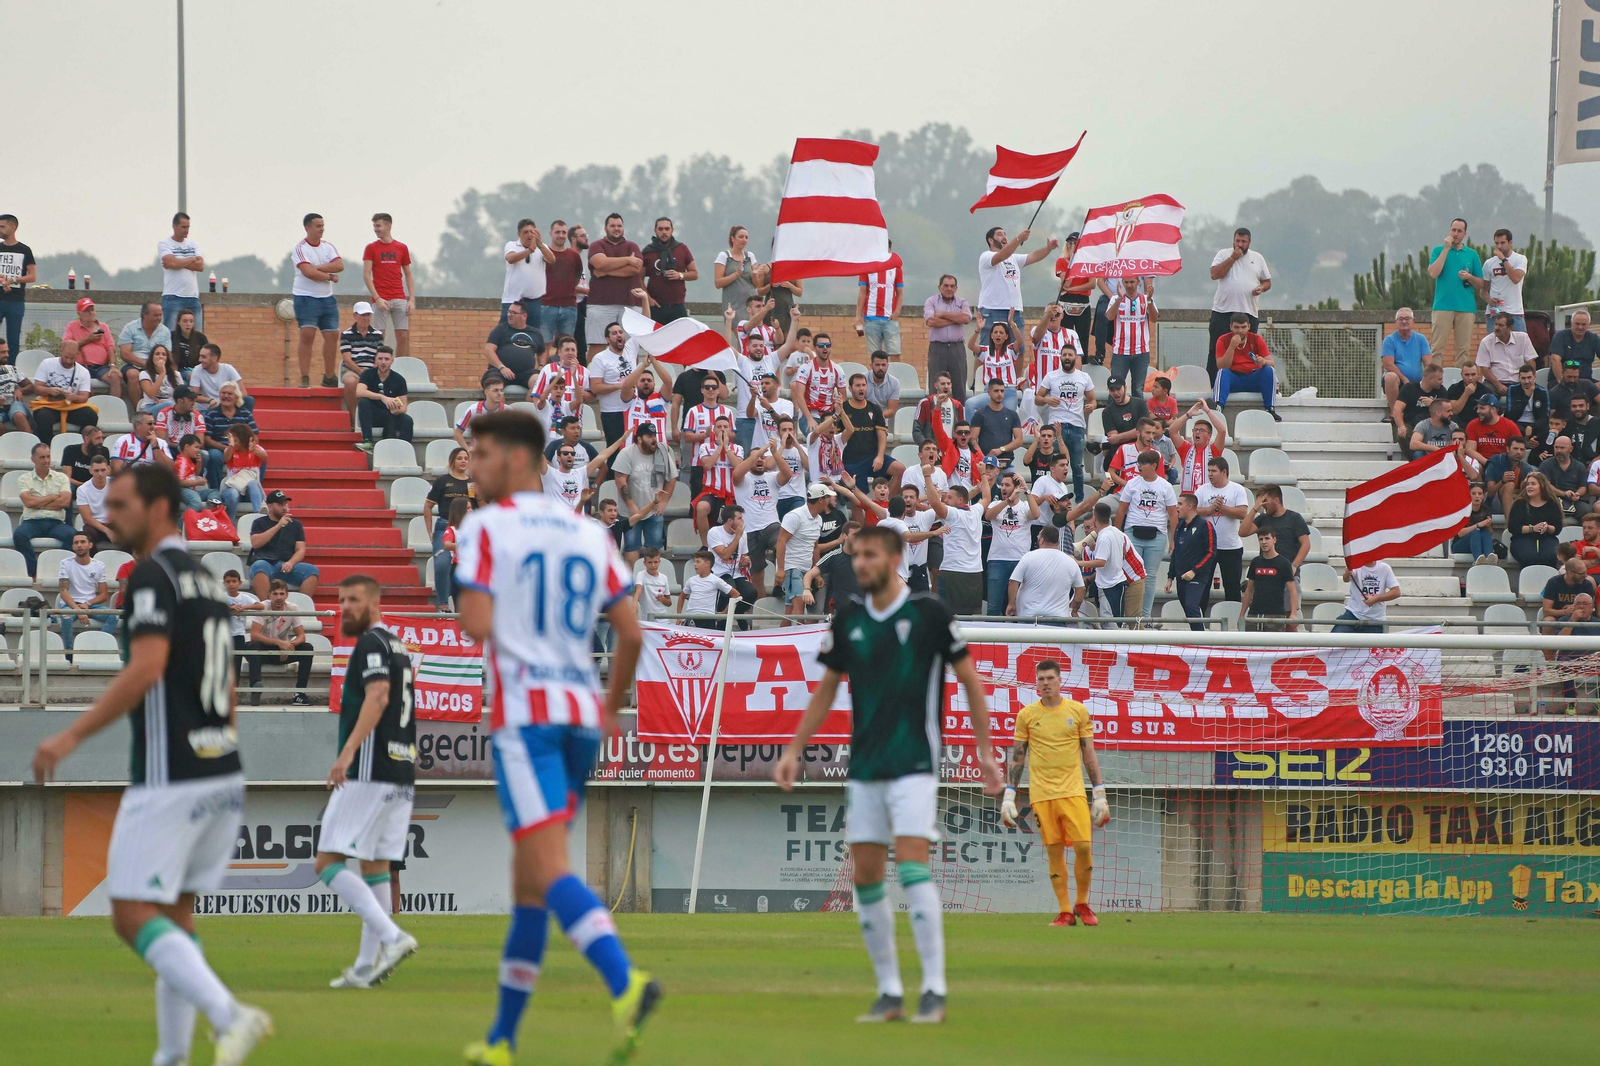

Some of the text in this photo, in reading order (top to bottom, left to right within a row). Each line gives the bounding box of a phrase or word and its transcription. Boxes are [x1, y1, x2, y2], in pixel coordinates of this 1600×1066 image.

[1080, 259, 1162, 274] ALGECIRAS C.F.
[1104, 268, 1123, 277] 1909
[753, 489, 770, 497] ACF
[1139, 499, 1157, 507] ACF
[822, 520, 837, 531] NIKE
[516, 551, 597, 638] 18
[1362, 586, 1380, 595] ACF
[200, 616, 232, 718] 10
[745, 643, 1330, 719] AECIRAS
[400, 667, 415, 729] 5
[1131, 721, 1176, 735] SUR
[1470, 733, 1573, 753] 1260 OM
[597, 766, 696, 781] cual quier momento
[1480, 757, 1573, 777] 93.0 FM
[1285, 804, 1414, 844] RADIO
[1423, 805, 1513, 845] TAXI
[1288, 874, 1493, 905] Descarga la App
[192, 894, 301, 915] REPUESTOS
[307, 894, 343, 914] DEL
[1106, 899, 1142, 908] INTER
